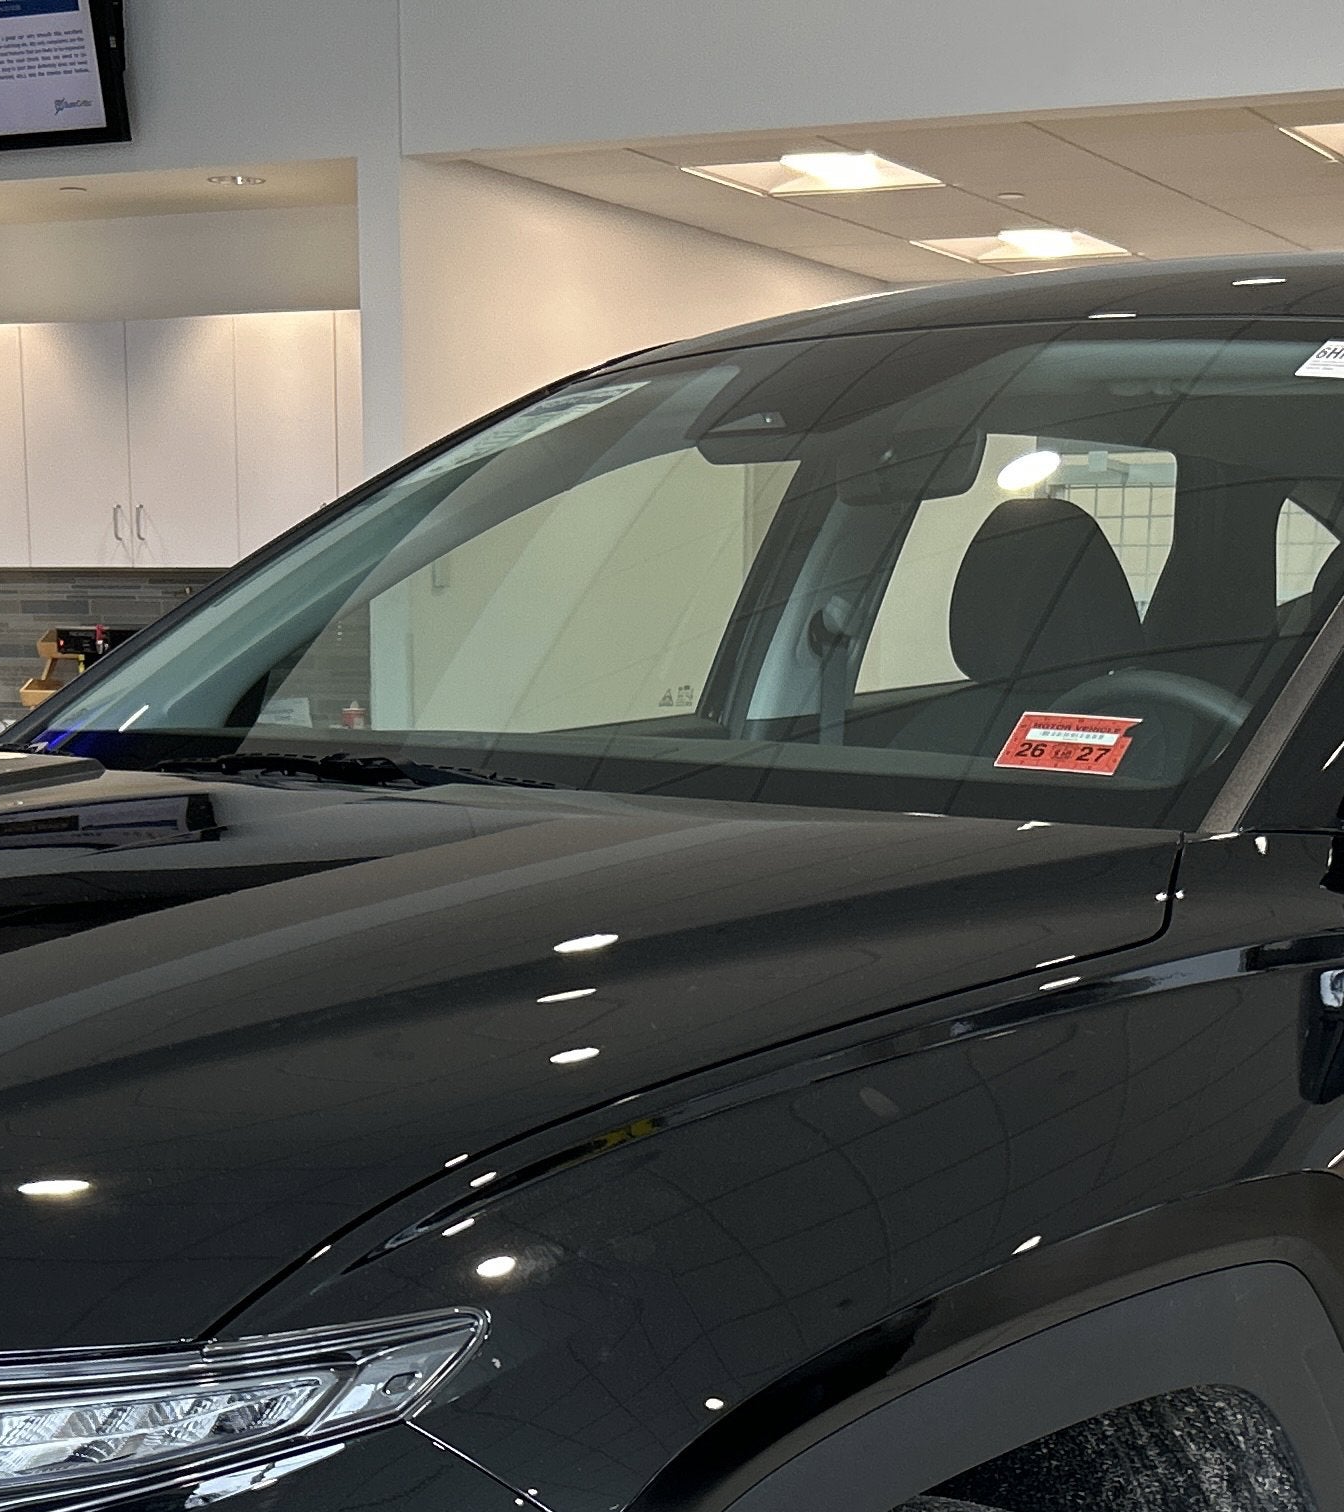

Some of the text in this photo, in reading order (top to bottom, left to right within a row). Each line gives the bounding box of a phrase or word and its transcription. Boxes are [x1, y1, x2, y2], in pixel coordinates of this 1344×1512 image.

[1033, 722, 1122, 734] MOTOR VEHICLE
[1014, 742, 1047, 758] 26
[1075, 746, 1111, 763] 27
